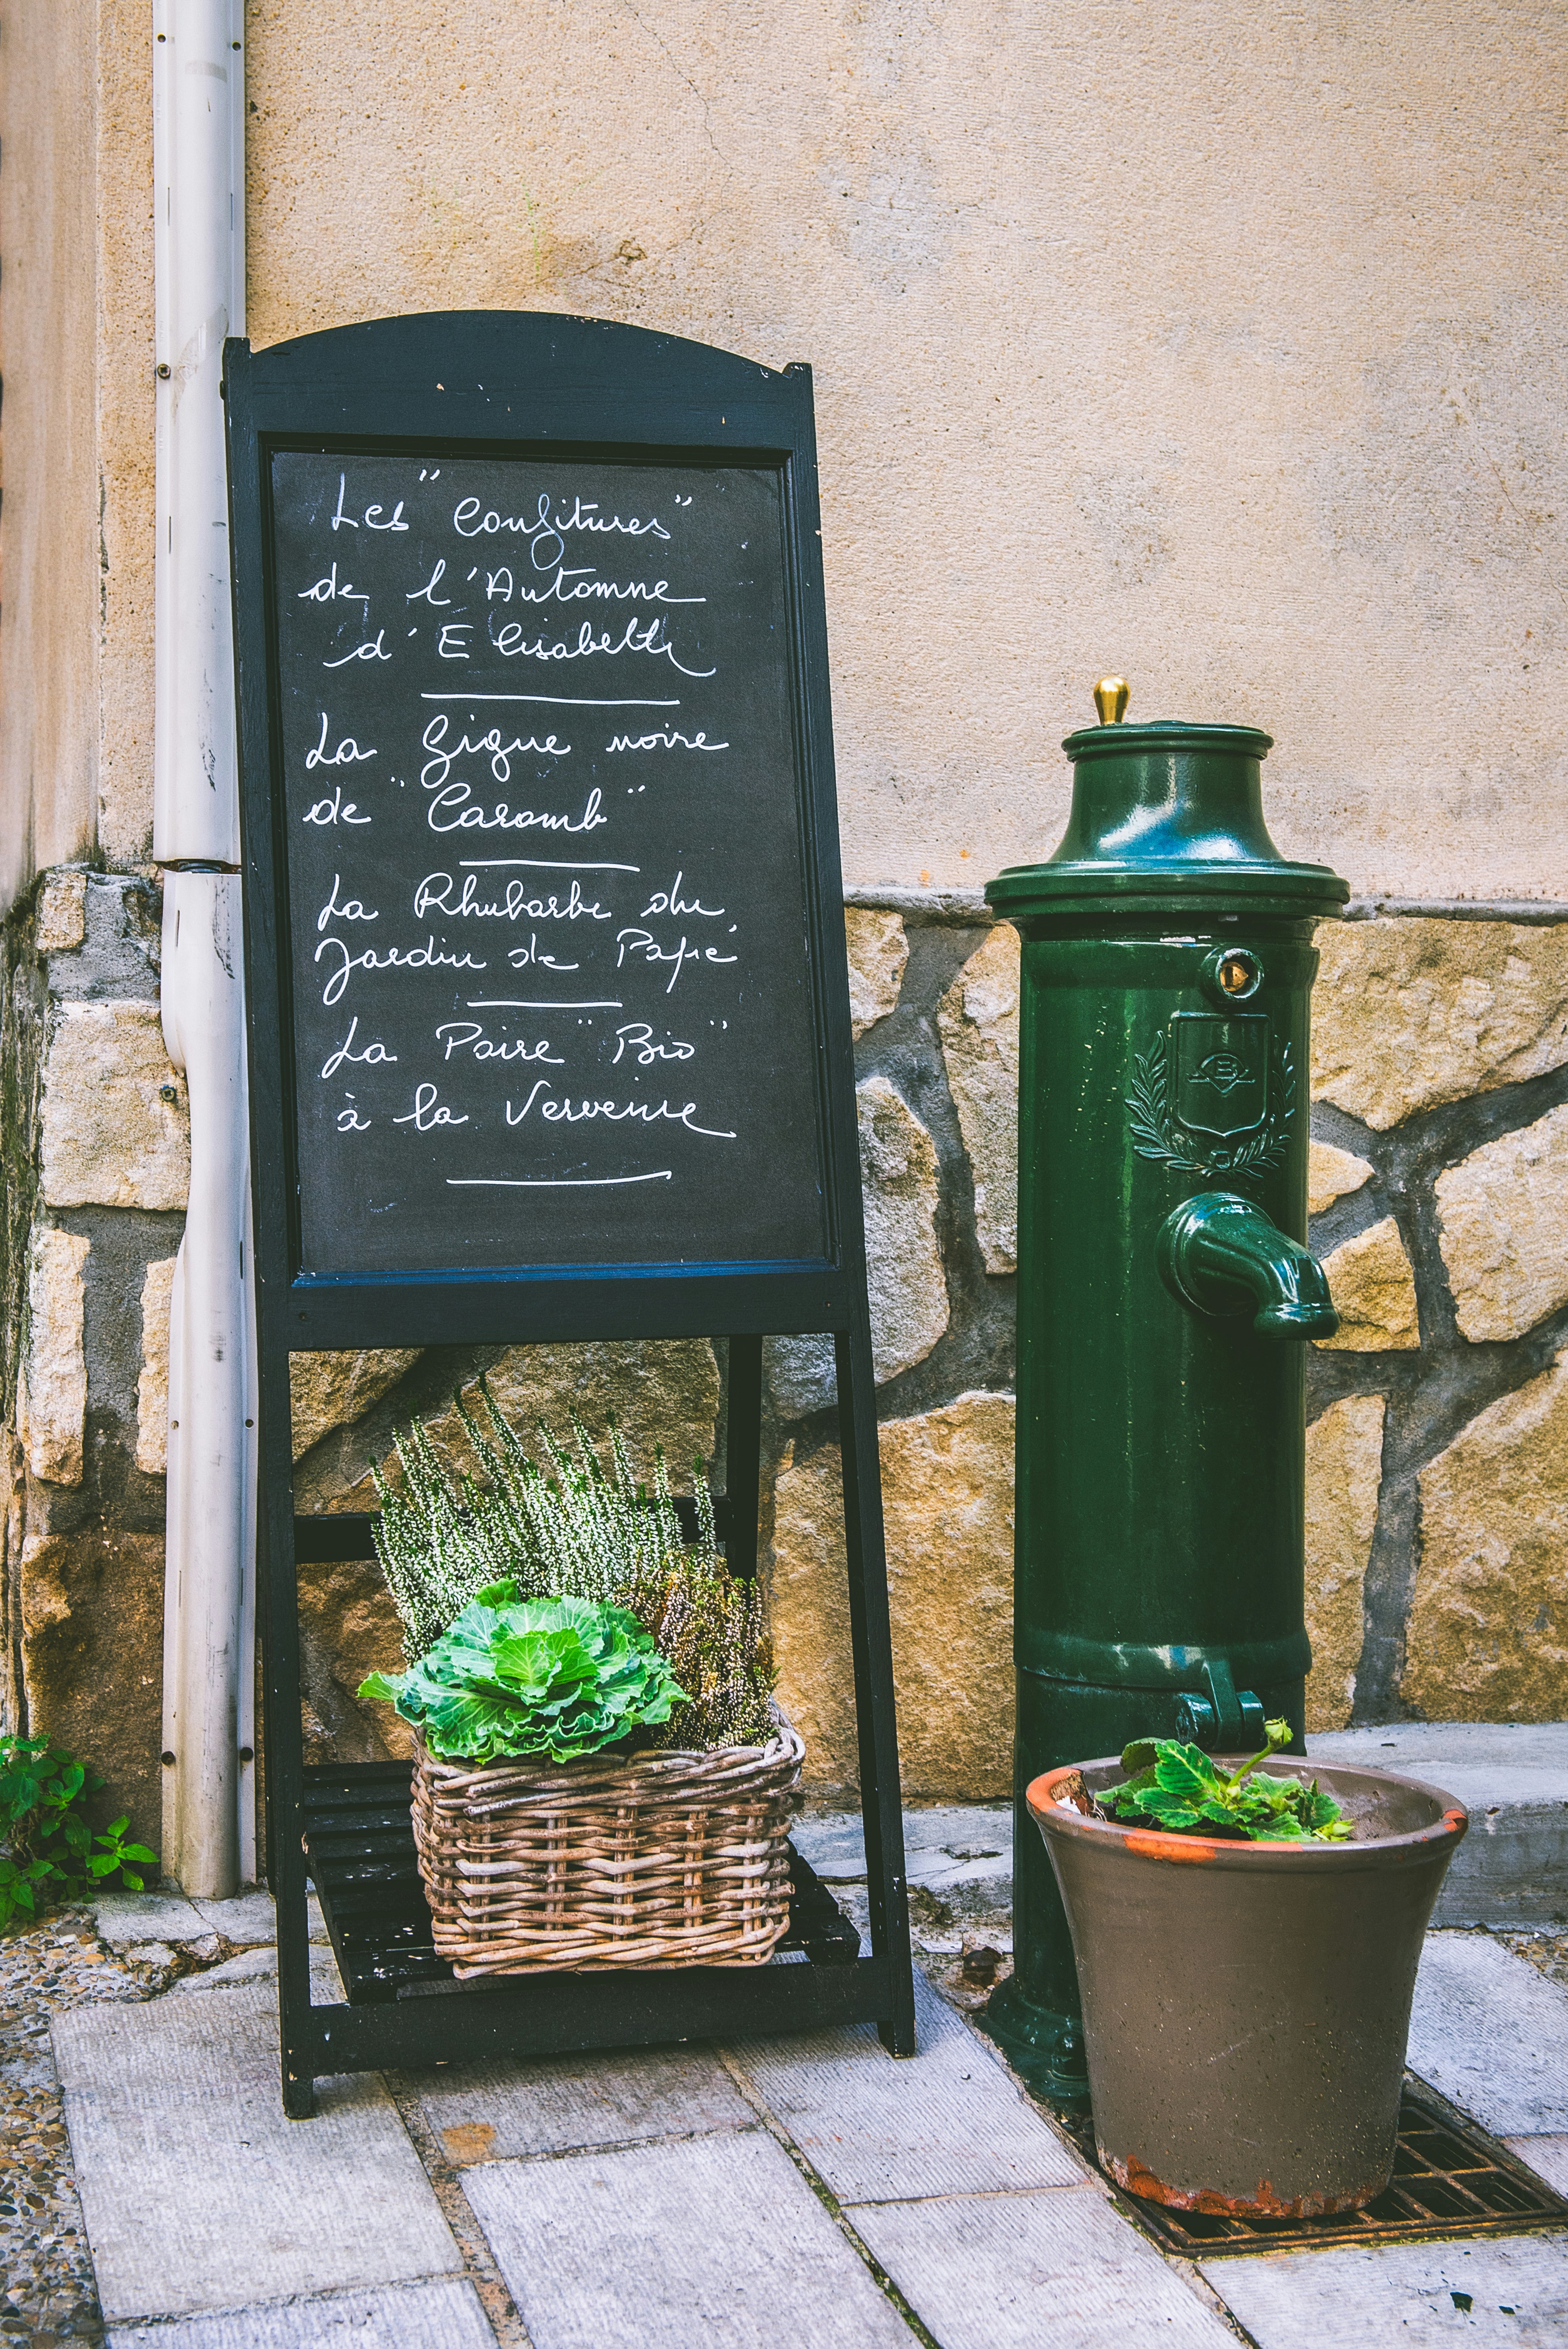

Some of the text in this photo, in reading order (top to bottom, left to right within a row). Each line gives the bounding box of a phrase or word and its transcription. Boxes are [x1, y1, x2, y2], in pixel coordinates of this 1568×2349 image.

[331, 473, 409, 531] Les
[298, 562, 369, 601] de
[306, 712, 377, 769] La
[302, 786, 372, 825] de
[318, 871, 725, 931] La Rhubarbe du
[315, 935, 486, 1005] Jardin
[508, 933, 579, 970] de
[321, 1017, 397, 1079] La
[436, 1022, 565, 1063] Poire
[337, 1077, 737, 1138] à la Verveine
